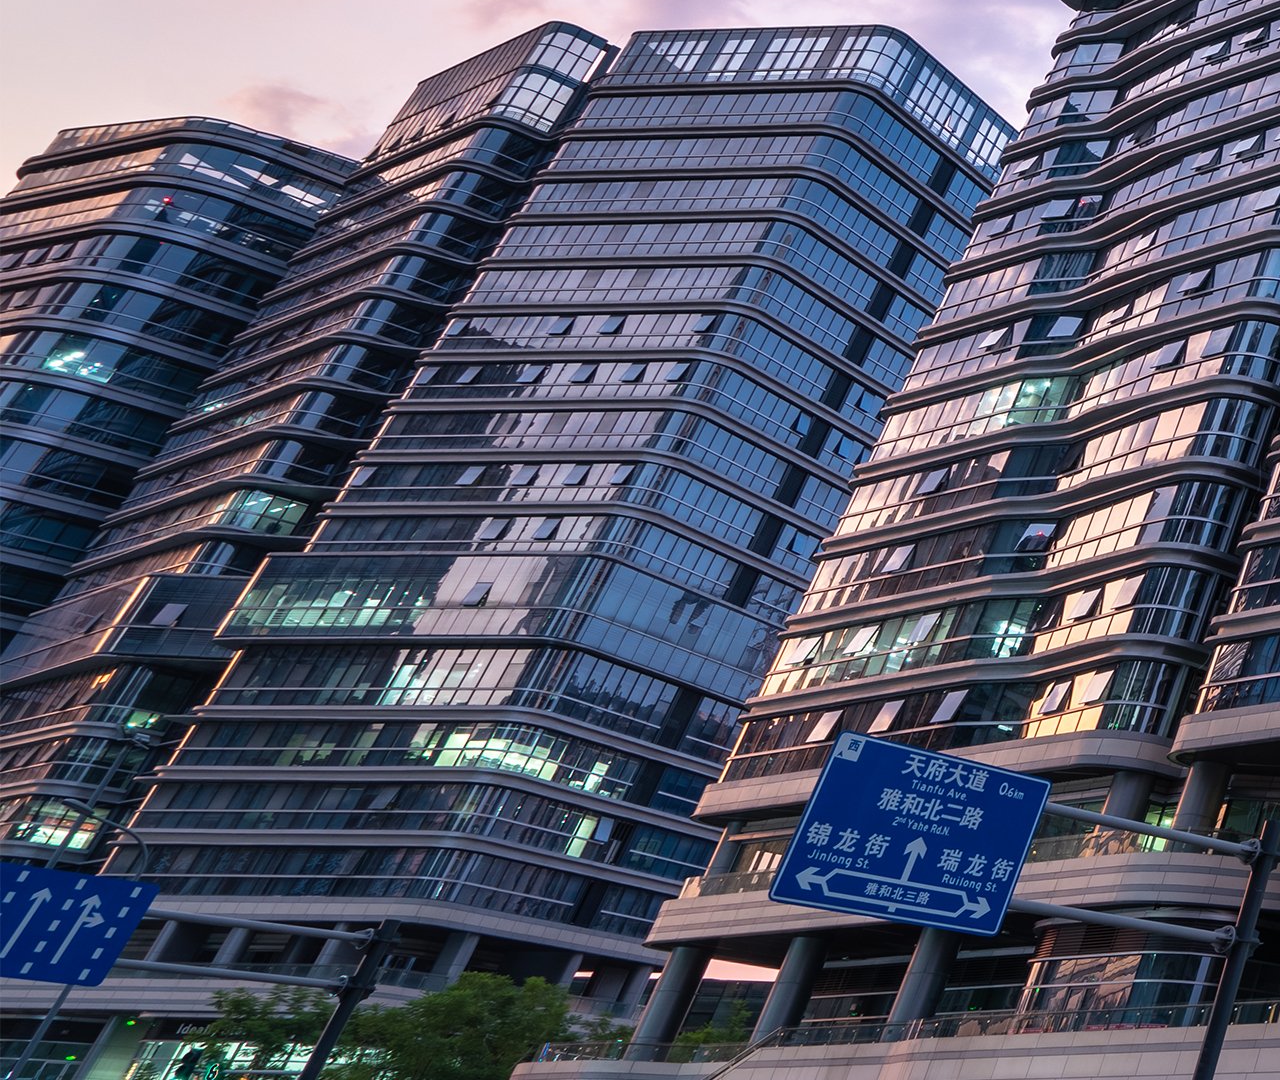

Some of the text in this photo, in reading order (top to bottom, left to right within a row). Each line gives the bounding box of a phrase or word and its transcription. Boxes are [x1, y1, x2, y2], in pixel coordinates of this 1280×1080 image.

[847, 738, 863, 752] 西
[901, 754, 990, 792] 天府大道
[912, 779, 968, 801] Tianfu Ave.
[877, 787, 984, 830] 雅和北二路
[907, 820, 929, 831] Yahe
[806, 821, 892, 858] 锦龙街
[807, 849, 870, 869] Jinlong St.
[937, 848, 1015, 882] 瑞龙街
[864, 882, 931, 905] 雅和北三路
[941, 873, 998, 893] Ruilong St.
